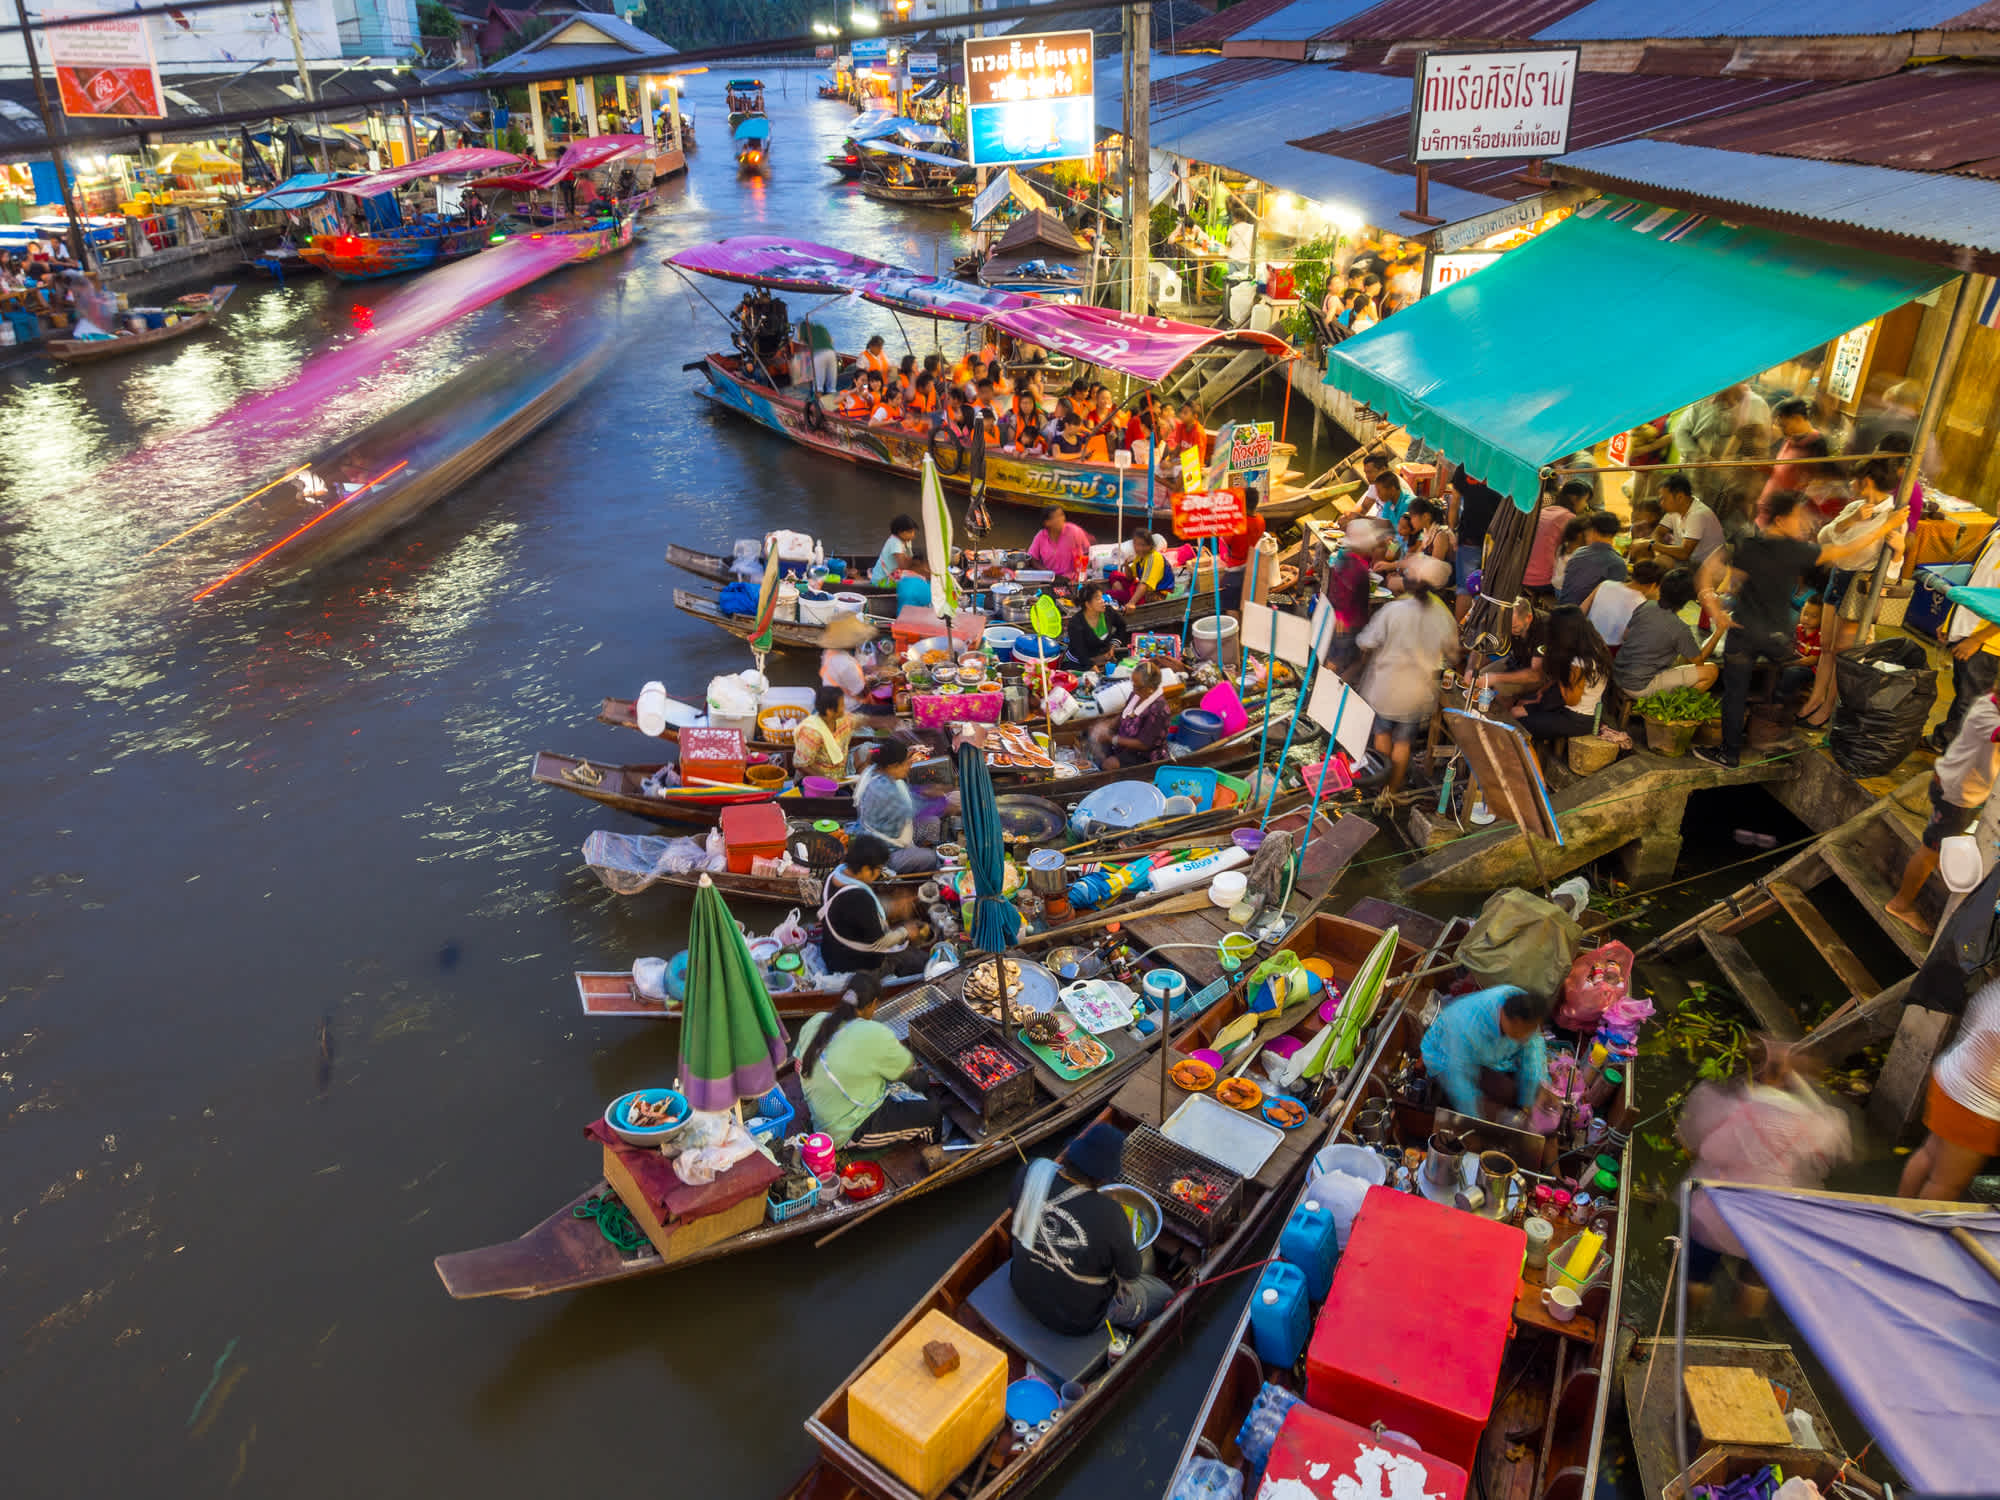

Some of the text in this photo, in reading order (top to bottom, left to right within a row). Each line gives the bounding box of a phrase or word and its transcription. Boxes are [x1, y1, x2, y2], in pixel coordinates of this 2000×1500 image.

[1424, 60, 1569, 112] ท่าเรือศิริโรจน์
[1421, 120, 1561, 152] บริการเรือชมหิ่งห้อย
